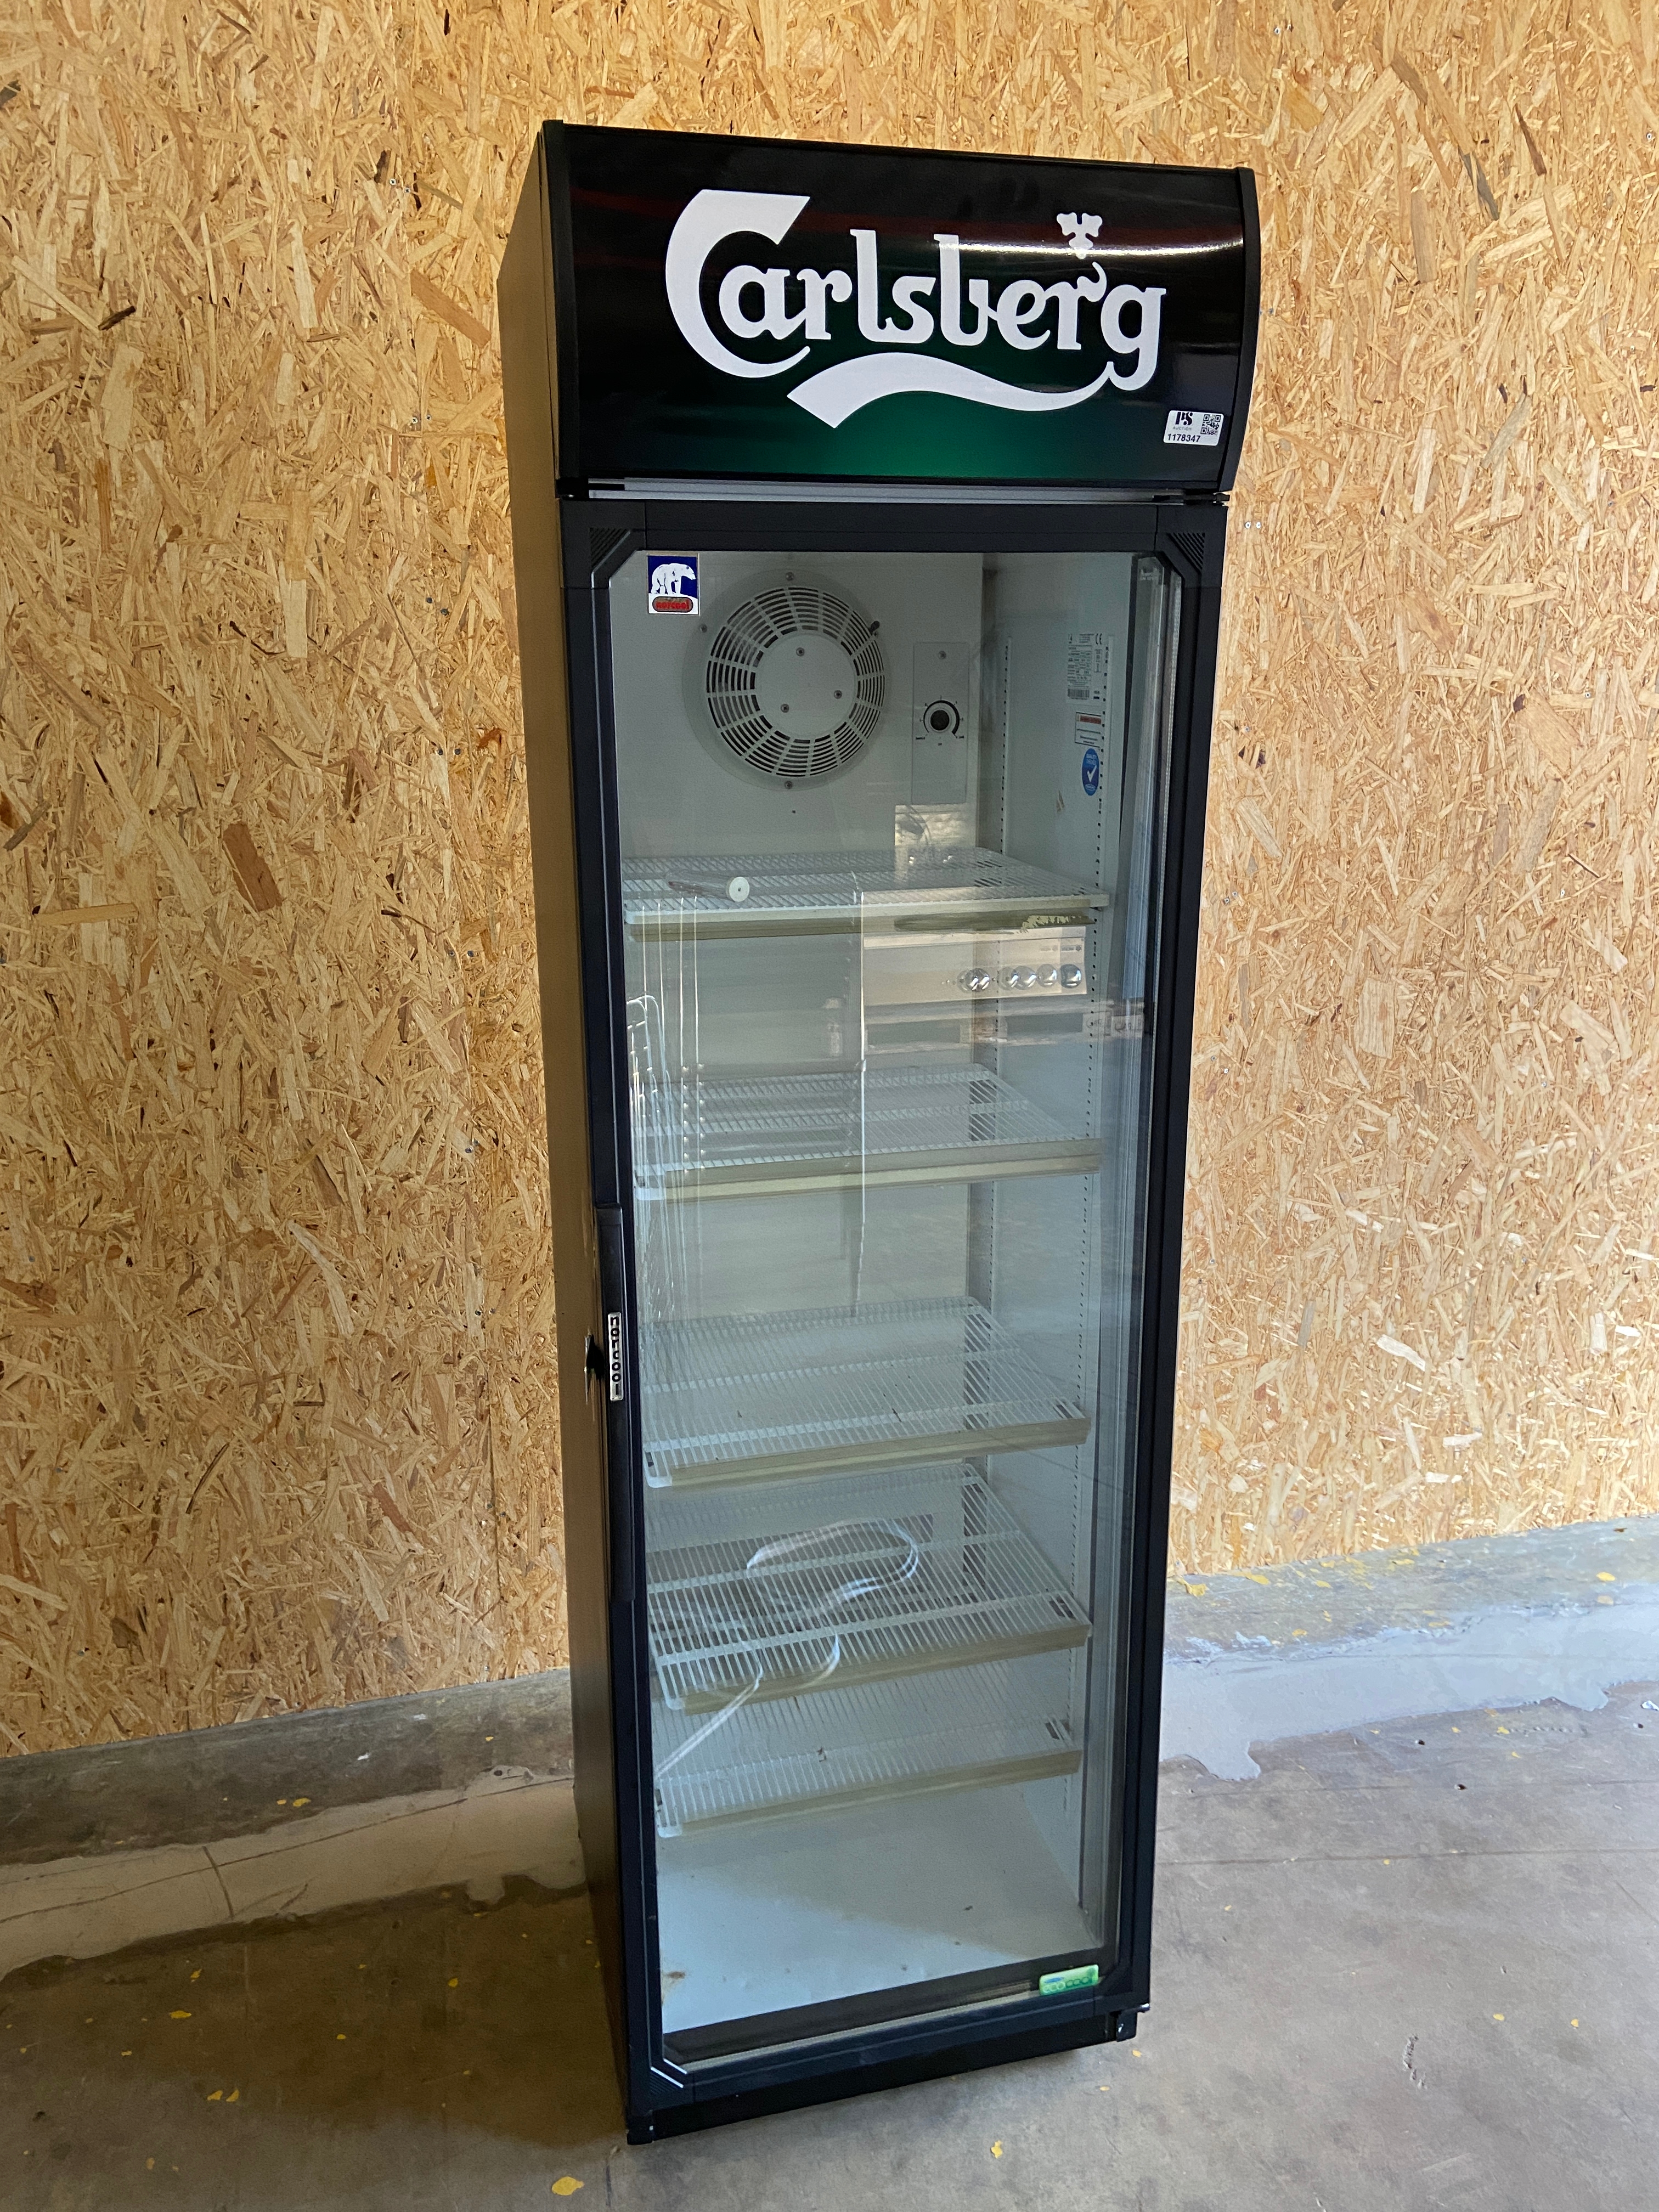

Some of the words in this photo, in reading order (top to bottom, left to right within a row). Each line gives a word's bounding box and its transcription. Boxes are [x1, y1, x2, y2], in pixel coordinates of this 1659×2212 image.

[665, 189, 1167, 391] Carlsberg
[1167, 433, 1201, 442] 1178347
[610, 1317, 622, 1395] norcool
